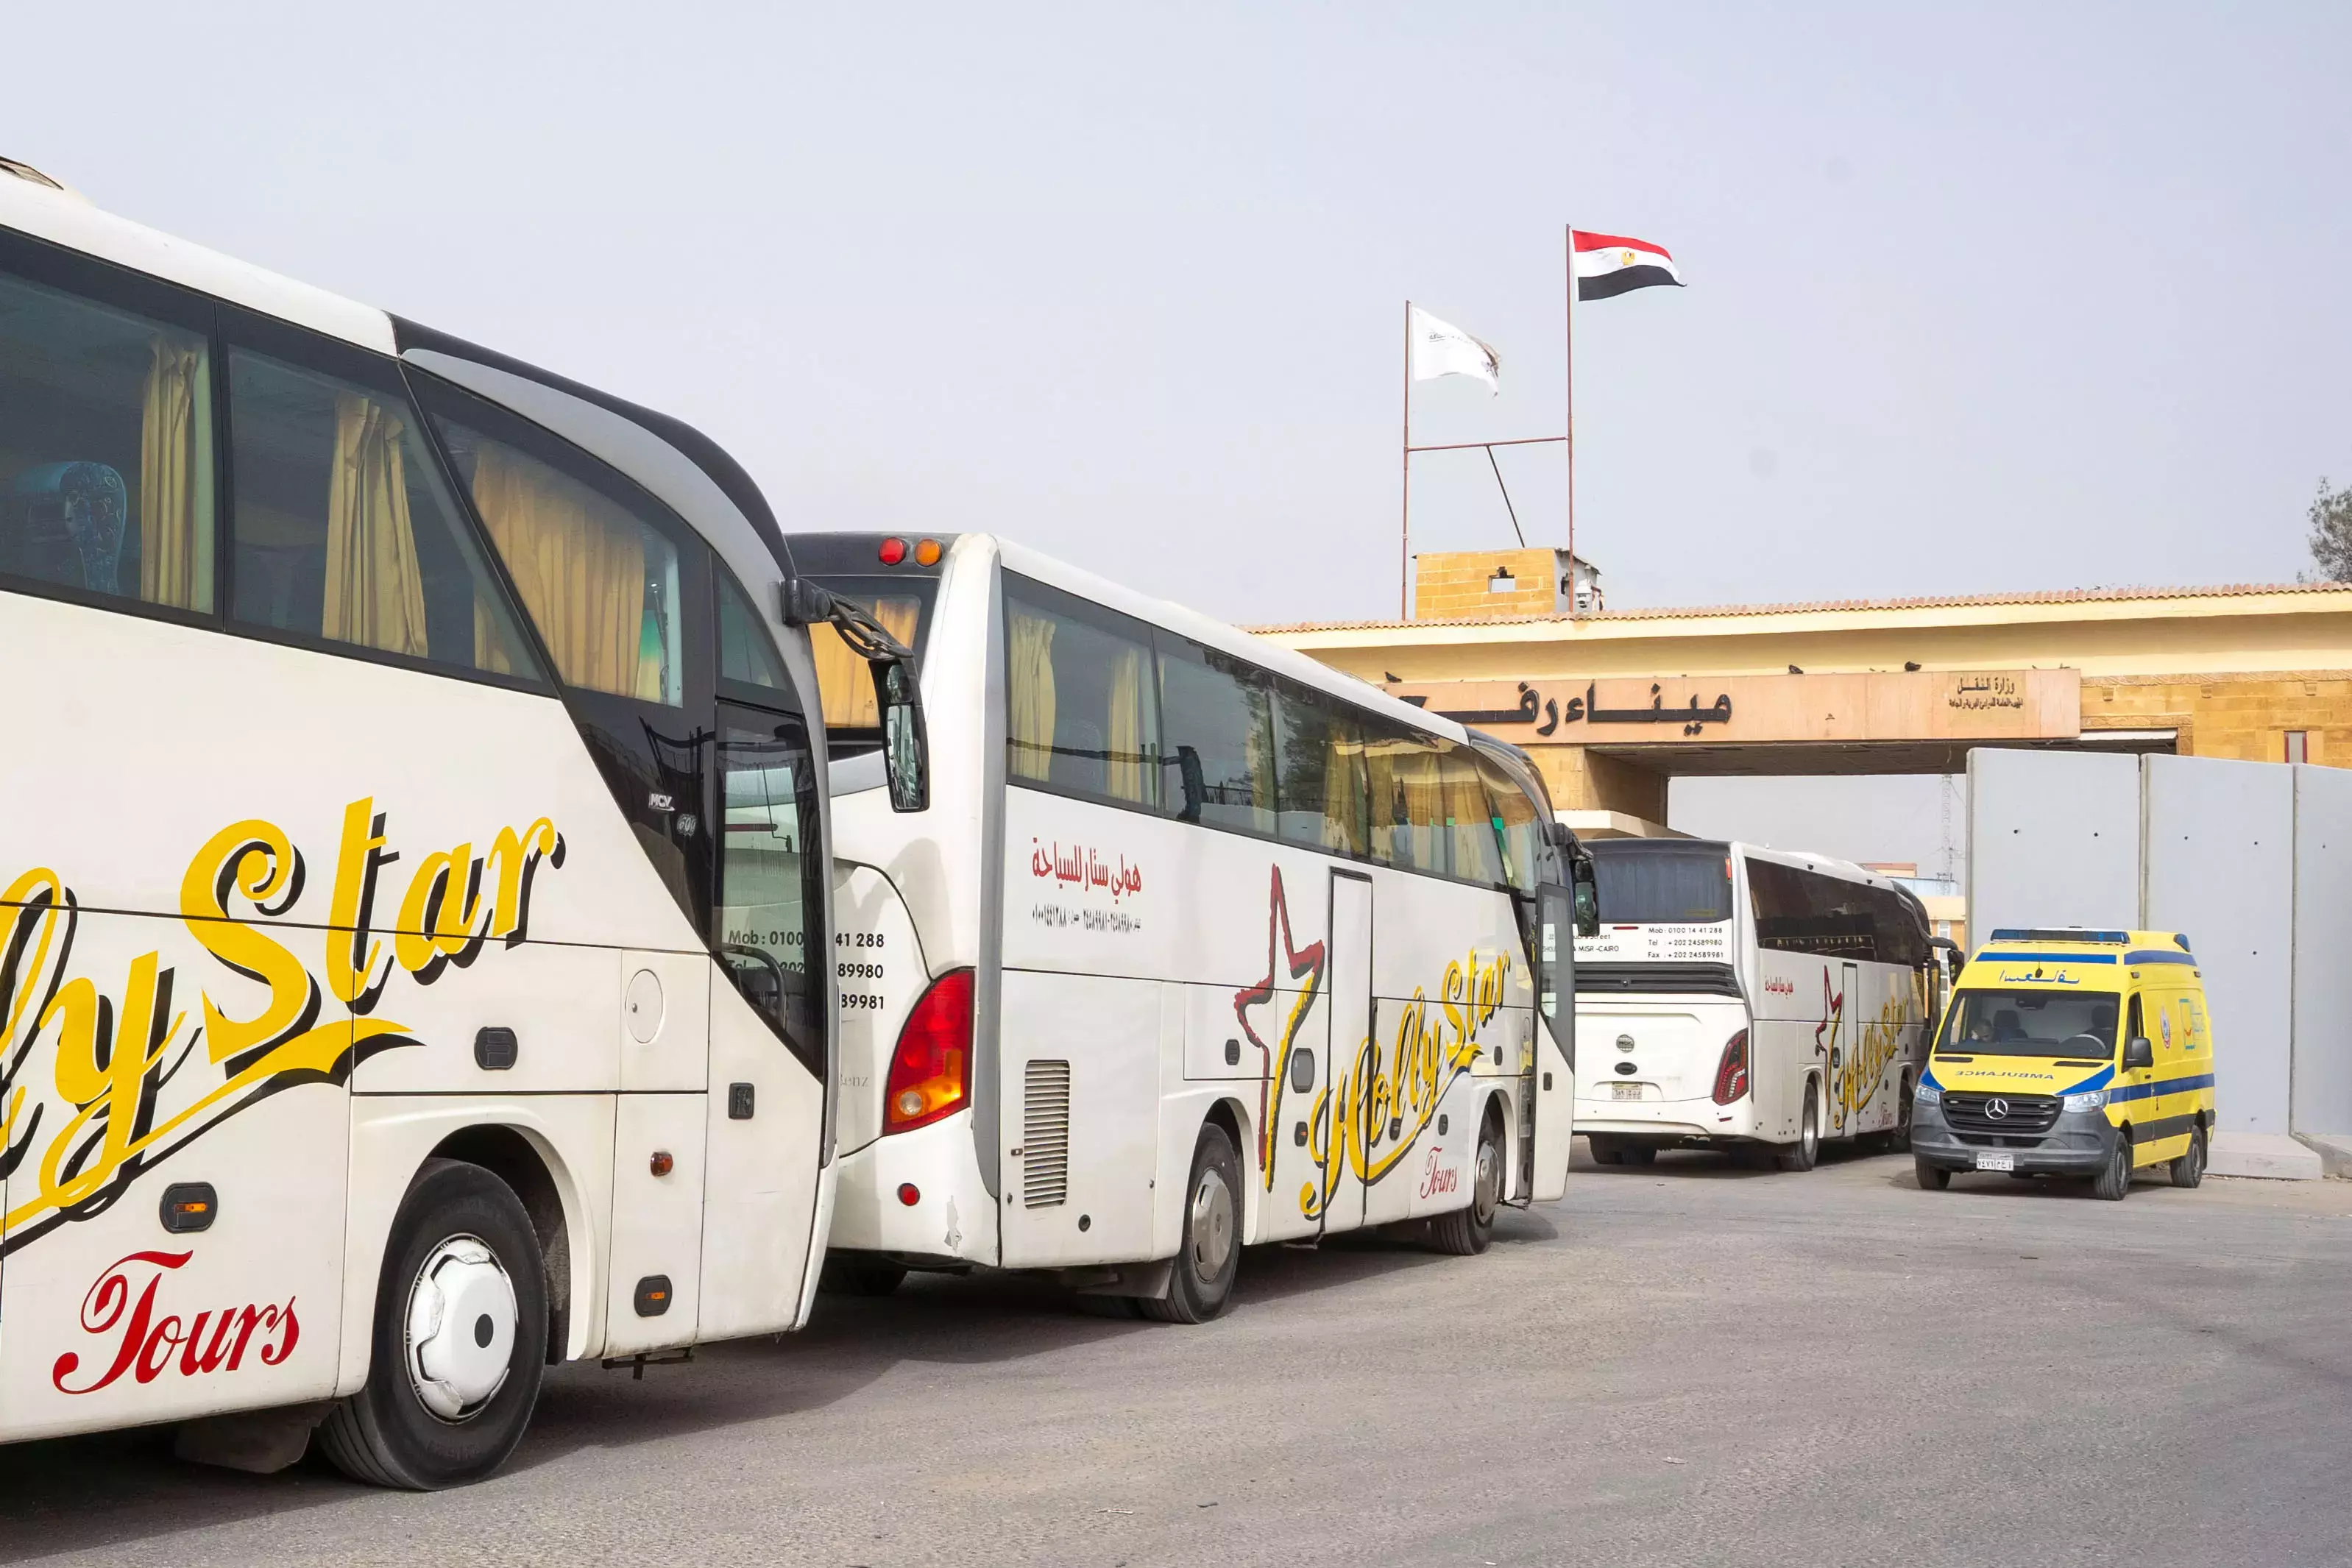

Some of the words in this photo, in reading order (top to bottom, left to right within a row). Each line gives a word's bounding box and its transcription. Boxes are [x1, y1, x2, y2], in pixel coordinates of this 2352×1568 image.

[1565, 679, 1732, 736] ميناء
[651, 793, 673, 808] MCV
[1032, 837, 1082, 889] للسياحة
[1085, 848, 1108, 892] ستار
[1111, 854, 1141, 904] هولي
[180, 796, 566, 1079] Star
[770, 931, 804, 946] 0100
[835, 932, 850, 946] 41
[856, 933, 884, 947] 288
[837, 962, 884, 979] 89980
[841, 994, 884, 1010] 89981
[1300, 986, 1445, 1221] Holly
[1442, 946, 1511, 1065] Star
[1420, 1146, 1457, 1198] Tours
[53, 1250, 300, 1394] Tours
